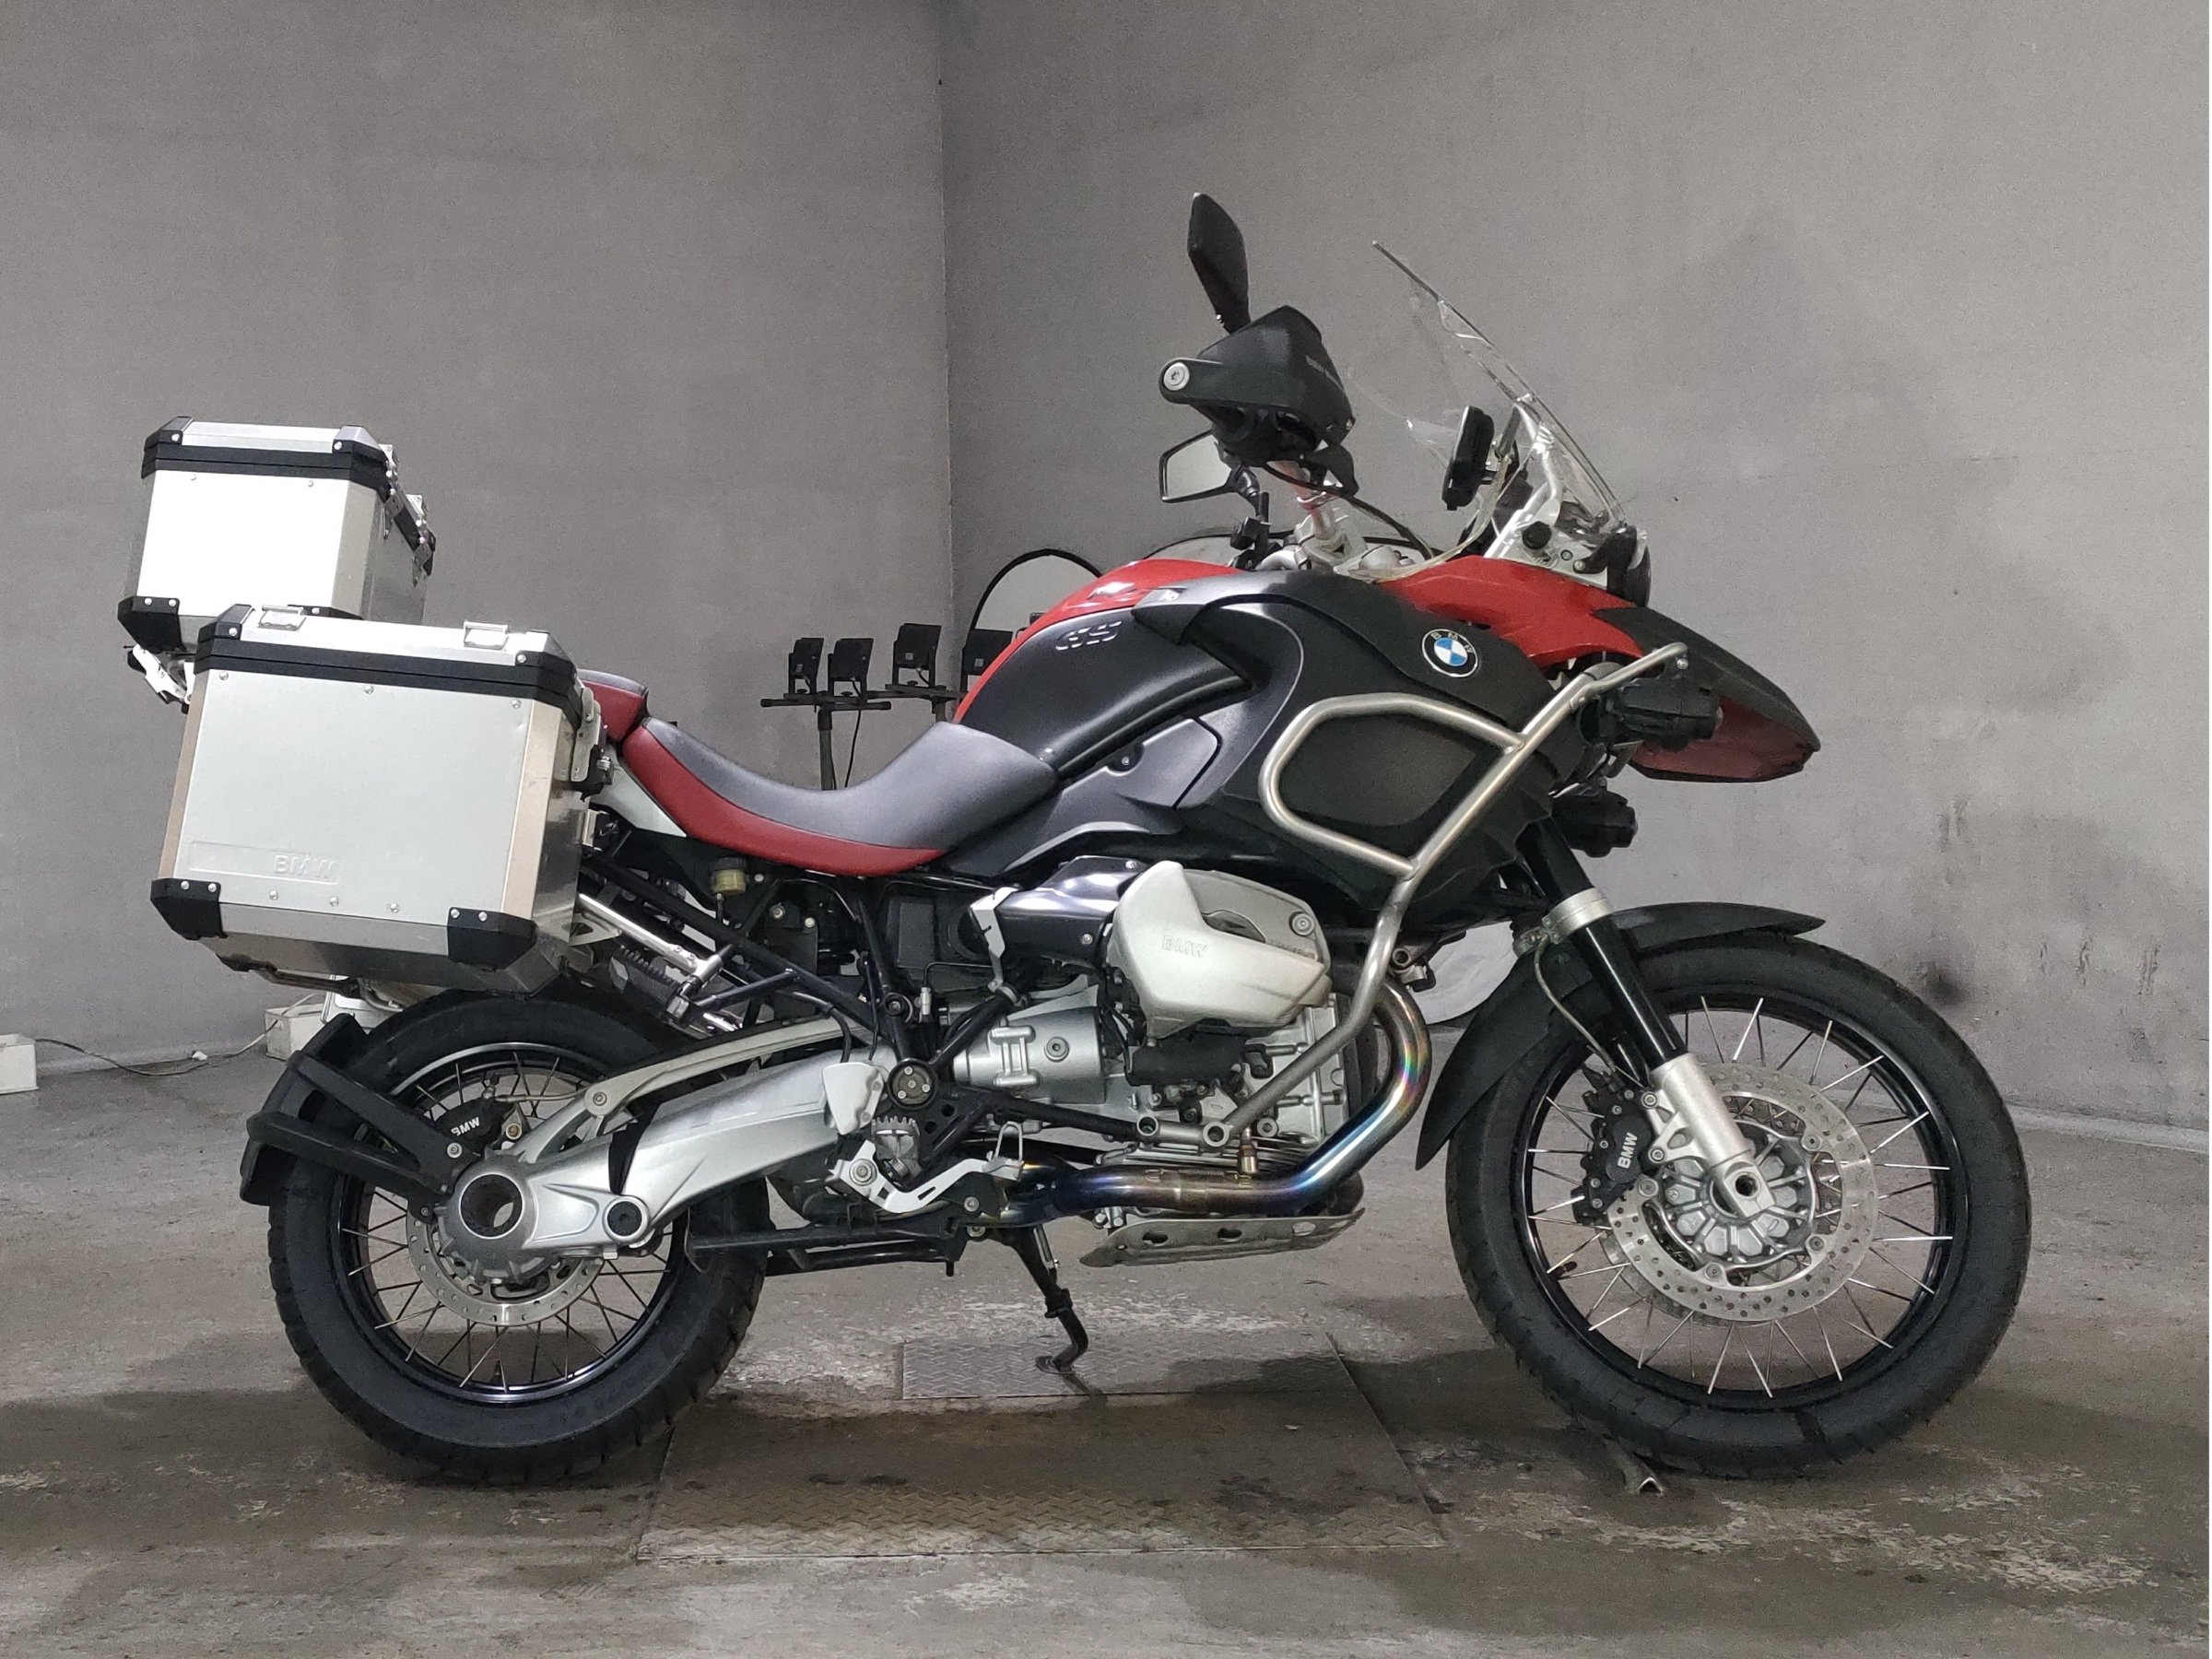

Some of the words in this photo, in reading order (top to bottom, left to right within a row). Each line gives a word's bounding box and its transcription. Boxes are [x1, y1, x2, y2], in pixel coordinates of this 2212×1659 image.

[1430, 631, 1476, 653] BMW
[272, 853, 338, 878] BMW
[1162, 935, 1208, 959] BMW
[1617, 1132, 1638, 1169] BMW
